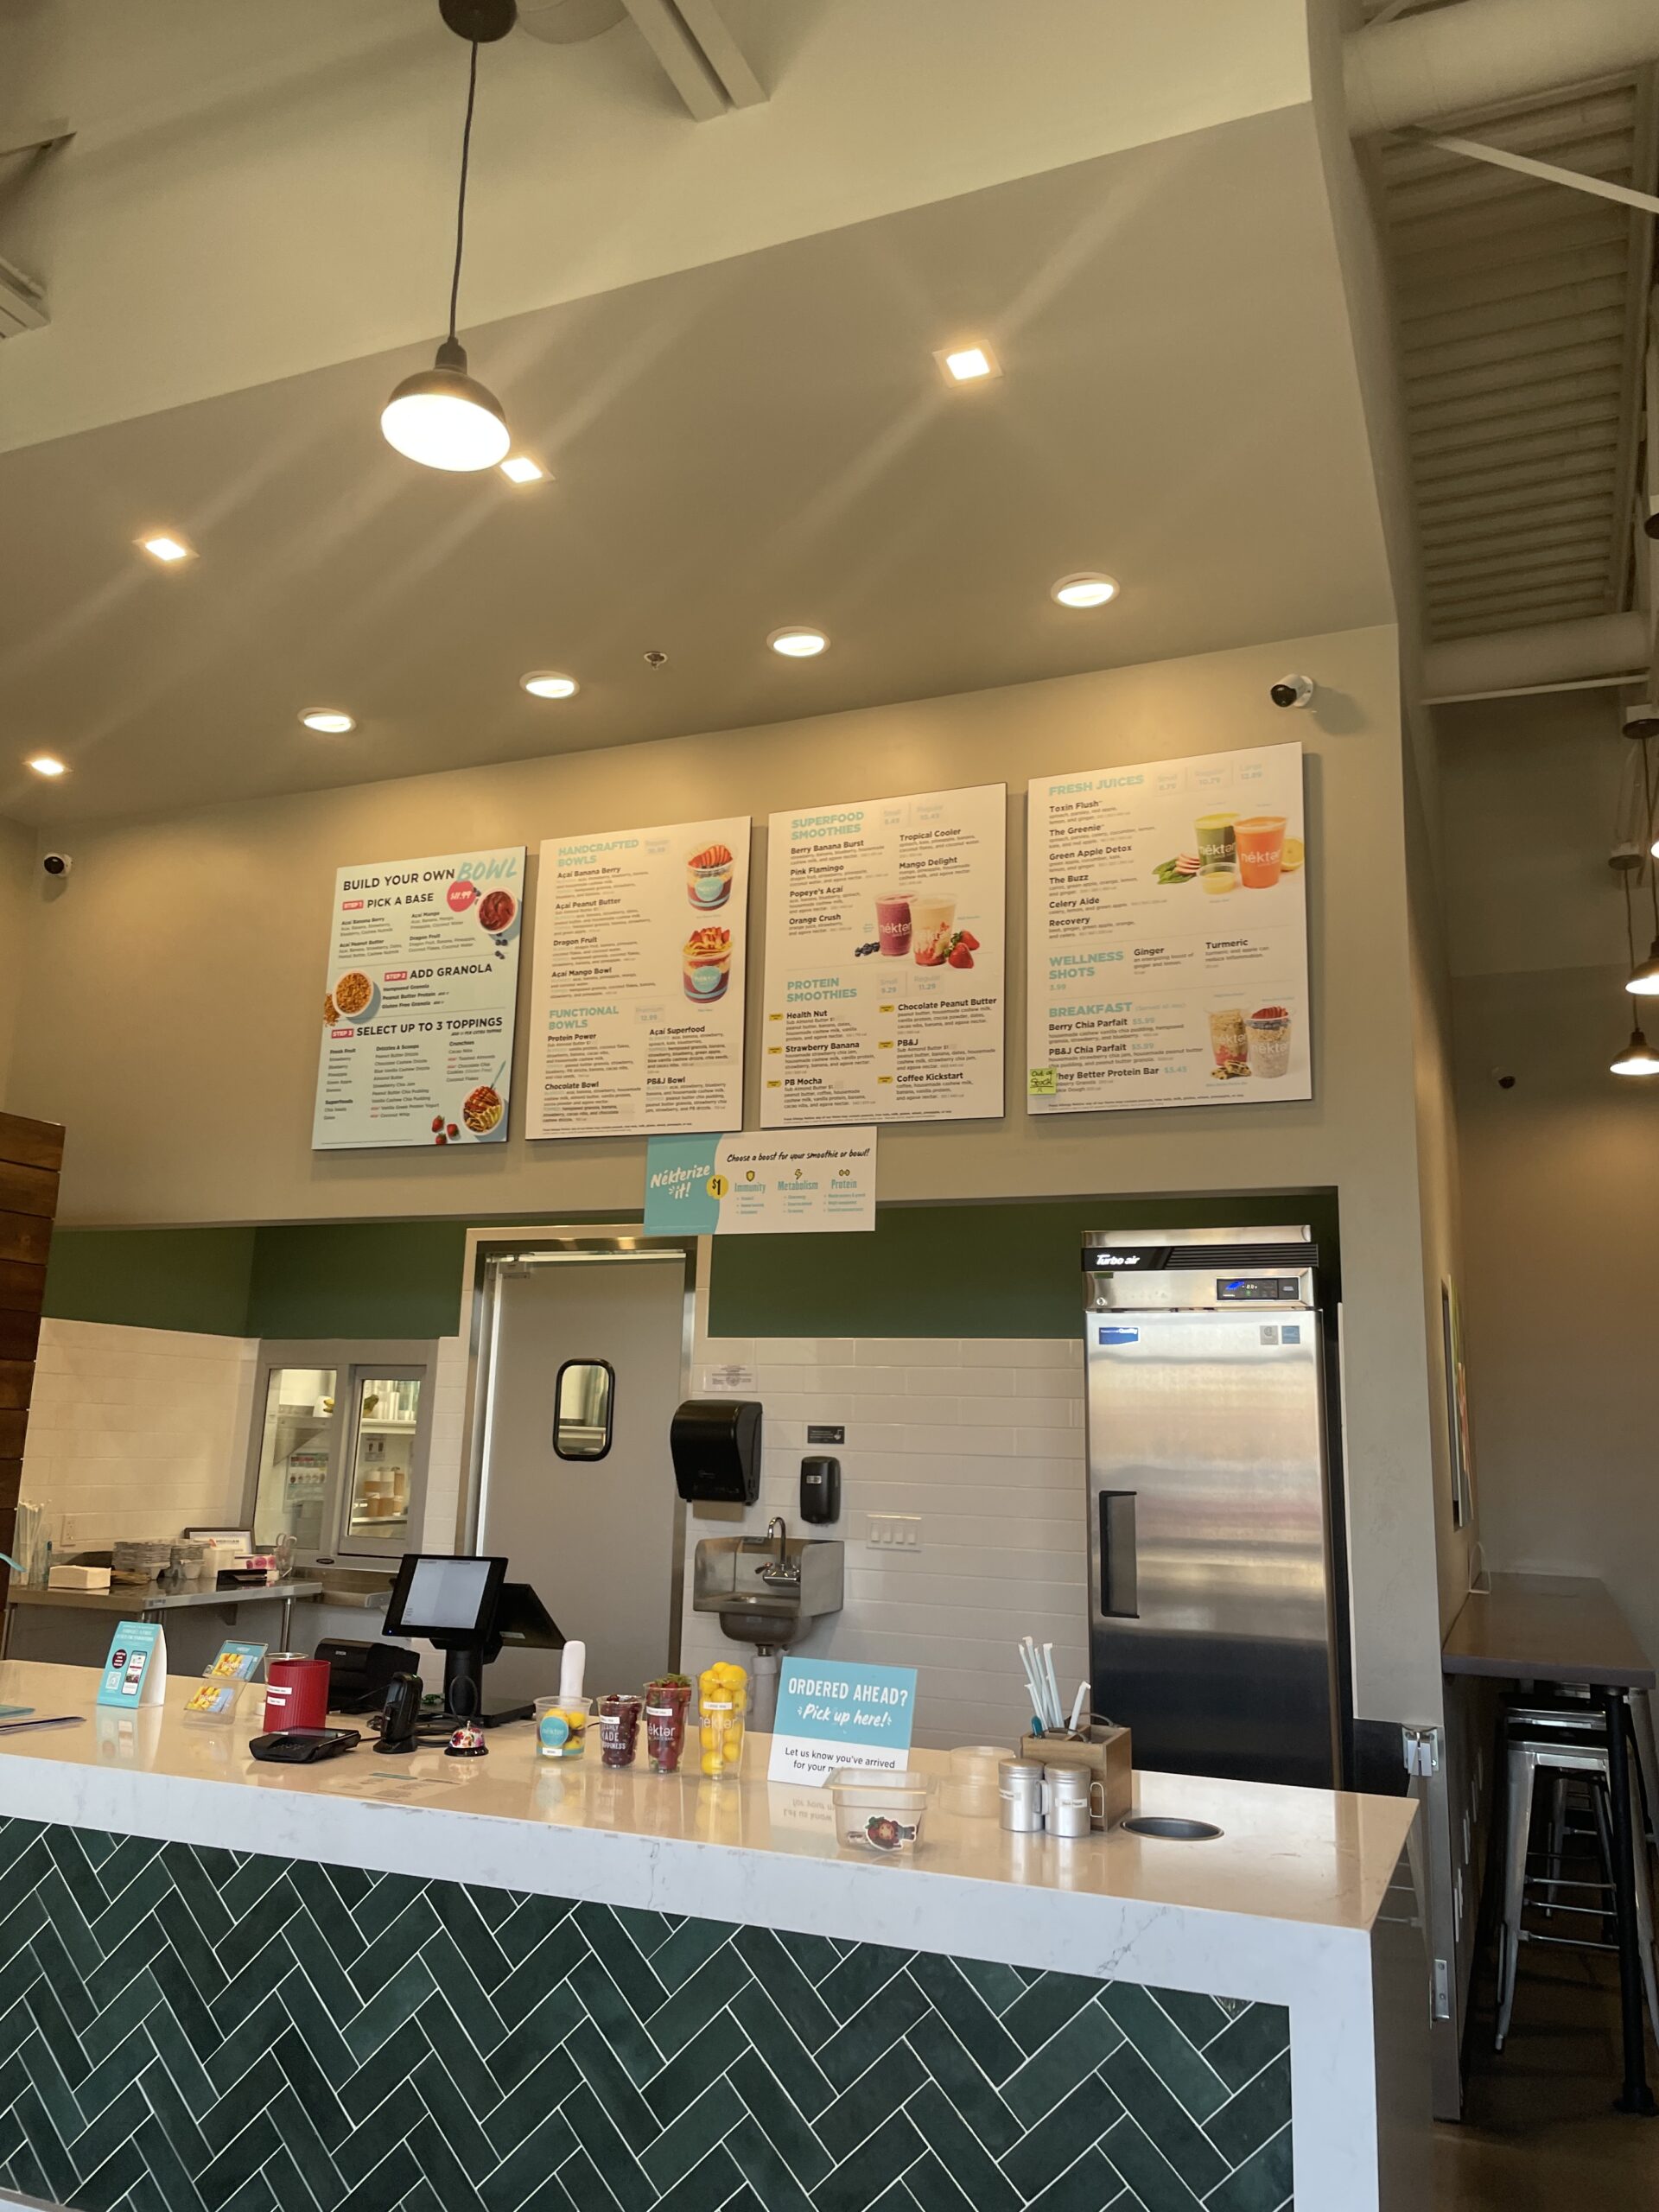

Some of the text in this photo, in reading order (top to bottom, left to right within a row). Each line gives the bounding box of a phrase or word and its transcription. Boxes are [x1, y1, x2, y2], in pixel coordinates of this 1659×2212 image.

[1049, 781, 1092, 797] FRESH
[1096, 774, 1145, 791] JUICES
[1049, 803, 1073, 812] Toxin
[791, 811, 864, 829] SUPERFOOD
[791, 823, 861, 841] SMOOTHIES
[899, 828, 961, 842] Tropical Cooler
[558, 839, 639, 856] HANDCRAFTED
[791, 846, 811, 856] Berry
[813, 842, 841, 851] Banana
[843, 840, 864, 849] Burst
[1049, 844, 1132, 861] Green Apple Detox
[557, 855, 597, 867] BOWLS
[899, 857, 957, 870] Mango Delight
[343, 856, 518, 891] BUILD YOUR OWN BOWL
[575, 868, 600, 877] Banana
[602, 867, 621, 876] Berry
[791, 864, 844, 876] Pink Flamingo
[1067, 874, 1089, 882] Buzz
[790, 888, 825, 899] Popeye's
[344, 901, 359, 910] STEP
[367, 898, 391, 908] PICK
[394, 897, 402, 906] A
[406, 893, 434, 904] BASE
[572, 899, 597, 908] Peanut
[1049, 897, 1100, 909] Celery Aide
[789, 913, 841, 926] Orange Crush
[1049, 916, 1090, 927] Recovery
[553, 938, 579, 948] Dragon
[1205, 938, 1249, 950] Turmeric
[1134, 946, 1165, 957] Ginger
[1049, 951, 1124, 967] WELLNESS
[410, 969, 433, 979] ADD
[437, 963, 493, 976] GRANOLA
[569, 969, 593, 978] Mango
[1049, 967, 1095, 979] SHOTS
[787, 977, 839, 990] PROTEIN
[786, 988, 857, 1002] SMOOTHIES
[898, 1001, 938, 1011] Chocolate
[1049, 1001, 1133, 1018] BREAKFAST
[549, 1006, 619, 1019] FUNCTIONAL
[786, 1011, 811, 1020] Health
[356, 1025, 397, 1037] SELECT
[400, 1022, 415, 1033] UP
[418, 1021, 433, 1032] TO
[435, 1020, 443, 1030] 3
[446, 1017, 503, 1030] TOPPINGS
[549, 1019, 588, 1031] BOWLS
[666, 1026, 705, 1035] Superfood
[1048, 1022, 1073, 1032] Berry
[1075, 1020, 1095, 1029] Chia
[1096, 1018, 1128, 1027] Parfait
[547, 1033, 573, 1042] Protein
[785, 1043, 829, 1053] Strawberry
[1049, 1047, 1071, 1056] PB&J
[1074, 1046, 1094, 1054] Chia
[1096, 1044, 1127, 1052] Parfait
[897, 1071, 963, 1083] Coffee Kickstart
[1077, 1071, 1105, 1079] Better
[1108, 1068, 1141, 1077] Protein
[544, 1082, 580, 1090] Chocolate
[727, 1154, 750, 1162] Choose
[758, 1152, 776, 1160] boost
[778, 1152, 788, 1160] for
[790, 1153, 804, 1161] your
[806, 1149, 838, 1159] smoothie
[849, 1148, 870, 1157] bowl!
[650, 1164, 711, 1189] Nékterize
[712, 1179, 721, 1195] $1
[734, 1182, 766, 1193] Immunity
[778, 1180, 818, 1191] Metabolism
[831, 1179, 857, 1189] Protein
[675, 1182, 691, 1199] it!
[1096, 1254, 1140, 1265] Turbo air
[788, 1677, 909, 1707] ORDERED AHEAD?
[803, 1703, 888, 1727] Pick up here!
[648, 1723, 676, 1736] ékter
[785, 1747, 798, 1757] Let
[811, 1750, 834, 1761] know
[836, 1754, 863, 1765] you've
[865, 1757, 895, 1769] arrived
[793, 1761, 826, 1772] for your
